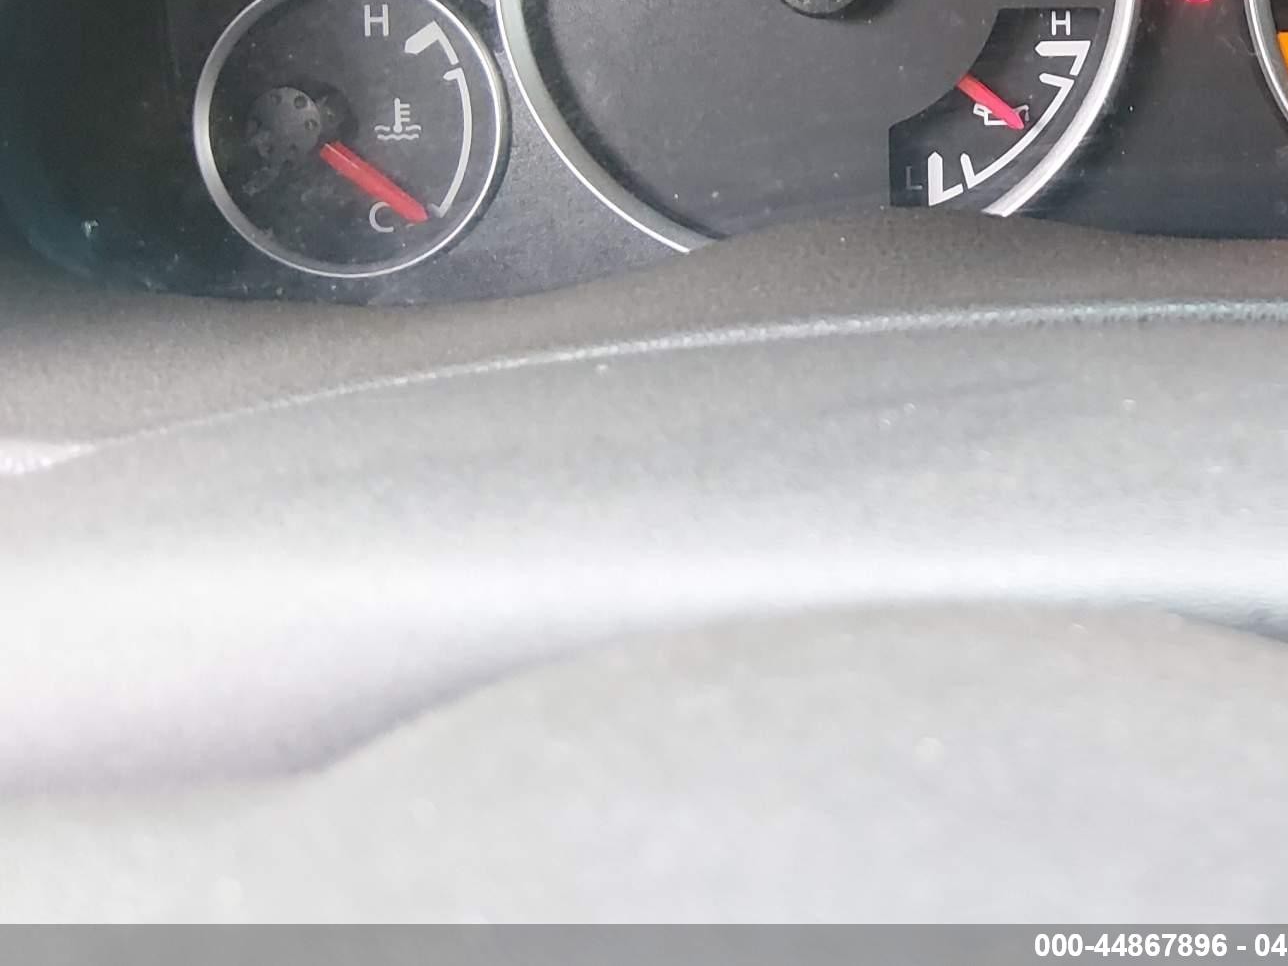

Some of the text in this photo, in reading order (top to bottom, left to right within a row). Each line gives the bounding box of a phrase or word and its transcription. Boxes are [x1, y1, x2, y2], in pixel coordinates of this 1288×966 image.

[364, 4, 389, 36] H
[1052, 12, 1070, 35] H
[369, 202, 395, 232] C
